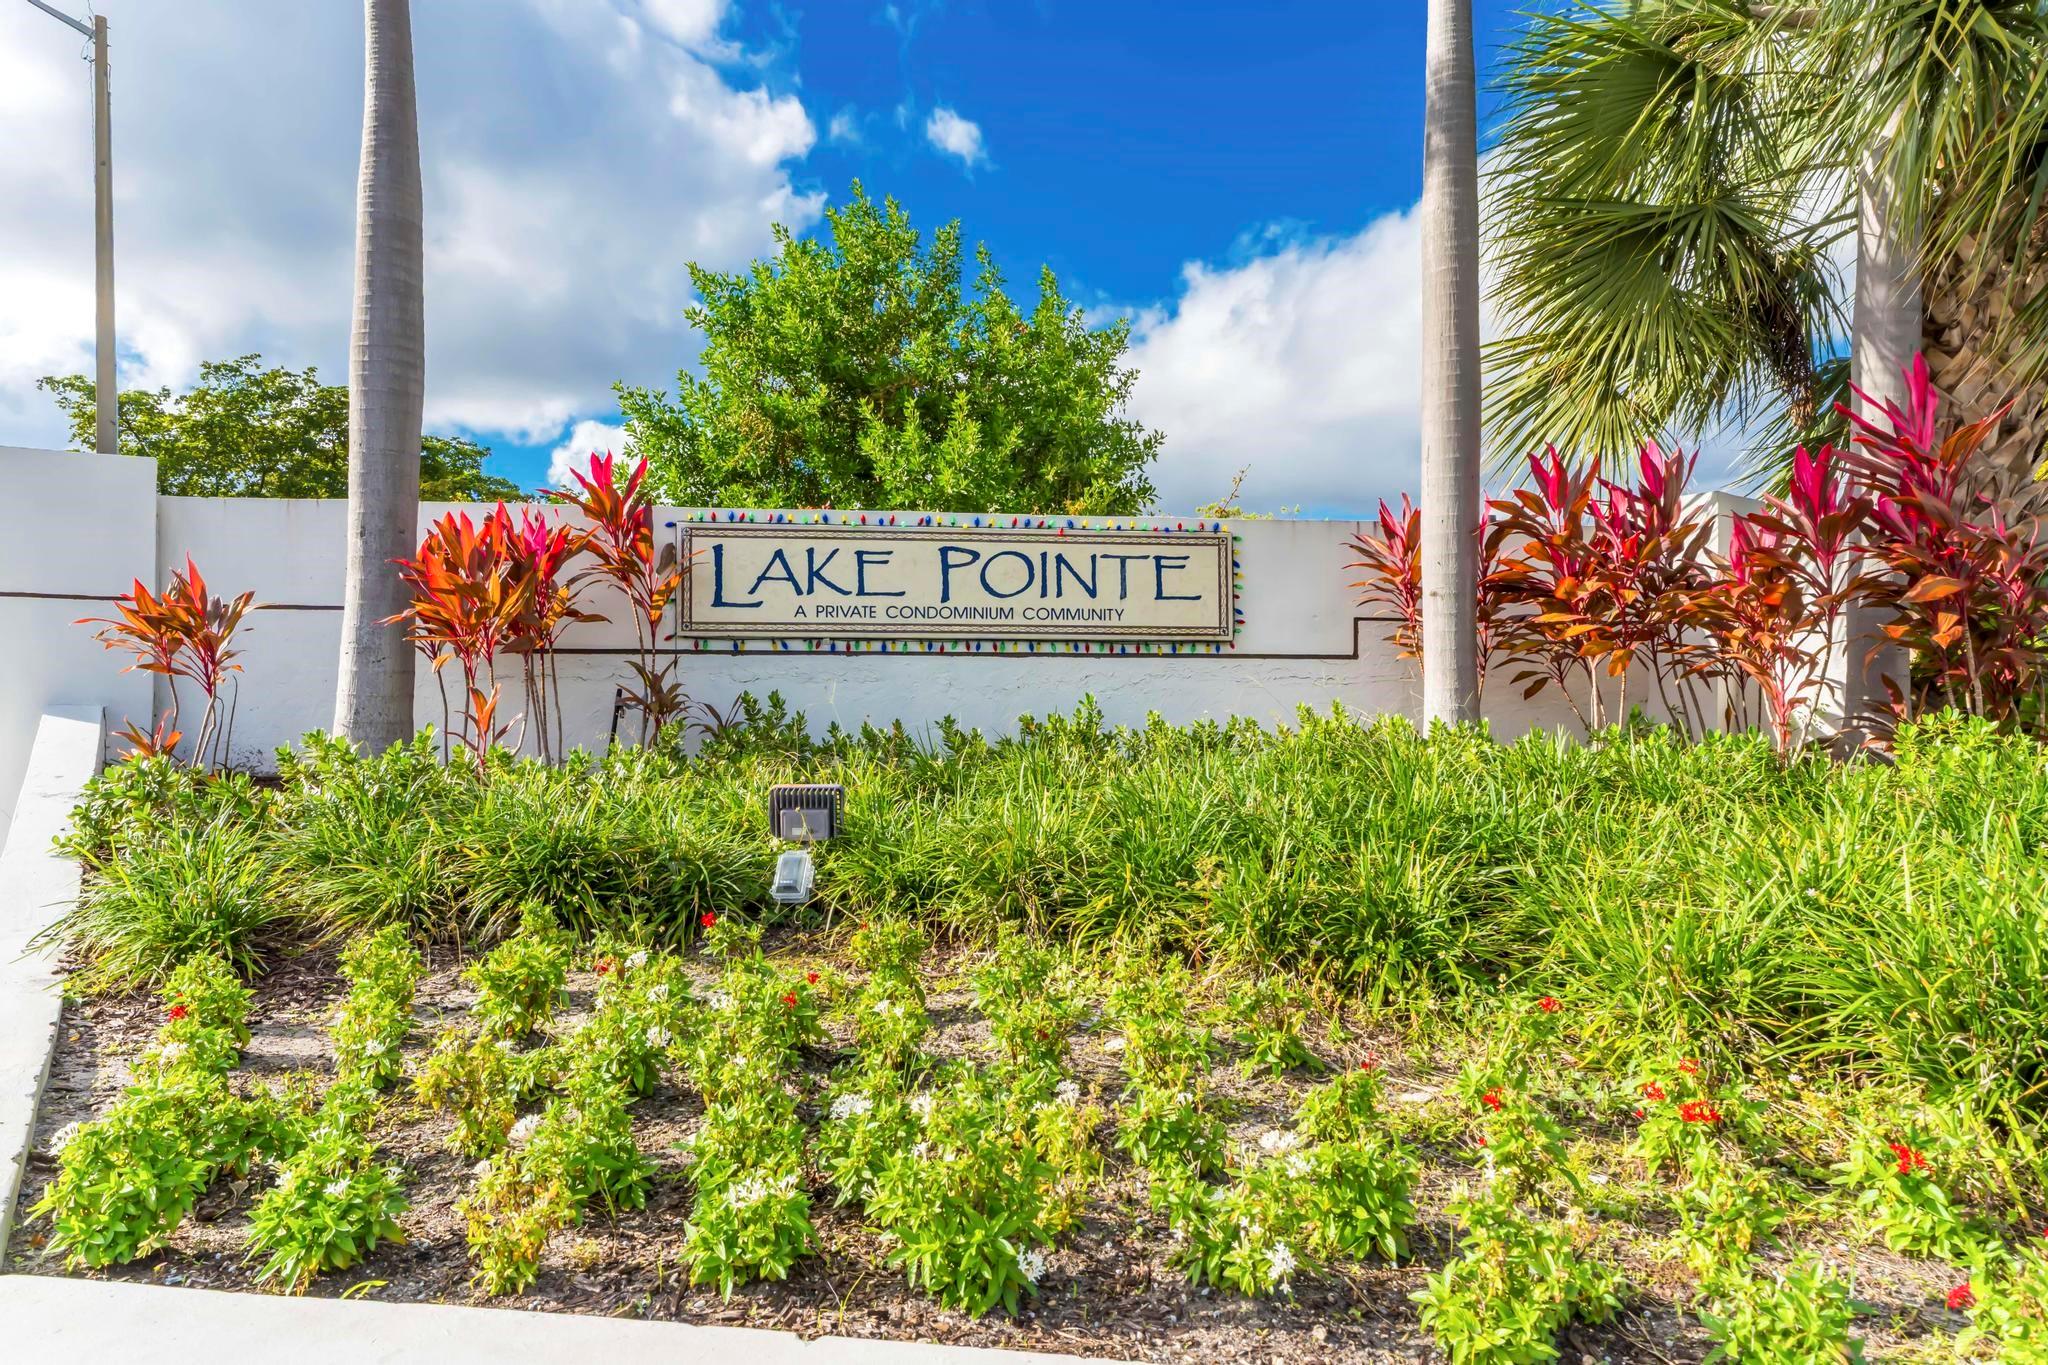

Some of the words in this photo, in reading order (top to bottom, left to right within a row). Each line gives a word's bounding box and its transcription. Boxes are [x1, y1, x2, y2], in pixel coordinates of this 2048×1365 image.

[710, 543, 906, 608] LAKE
[937, 545, 1202, 603] POINTE
[794, 605, 808, 618] A
[815, 604, 877, 619] PRIVATE
[885, 605, 1014, 620] CONDOMINIUM
[1022, 607, 1125, 621] COMMUNITY
